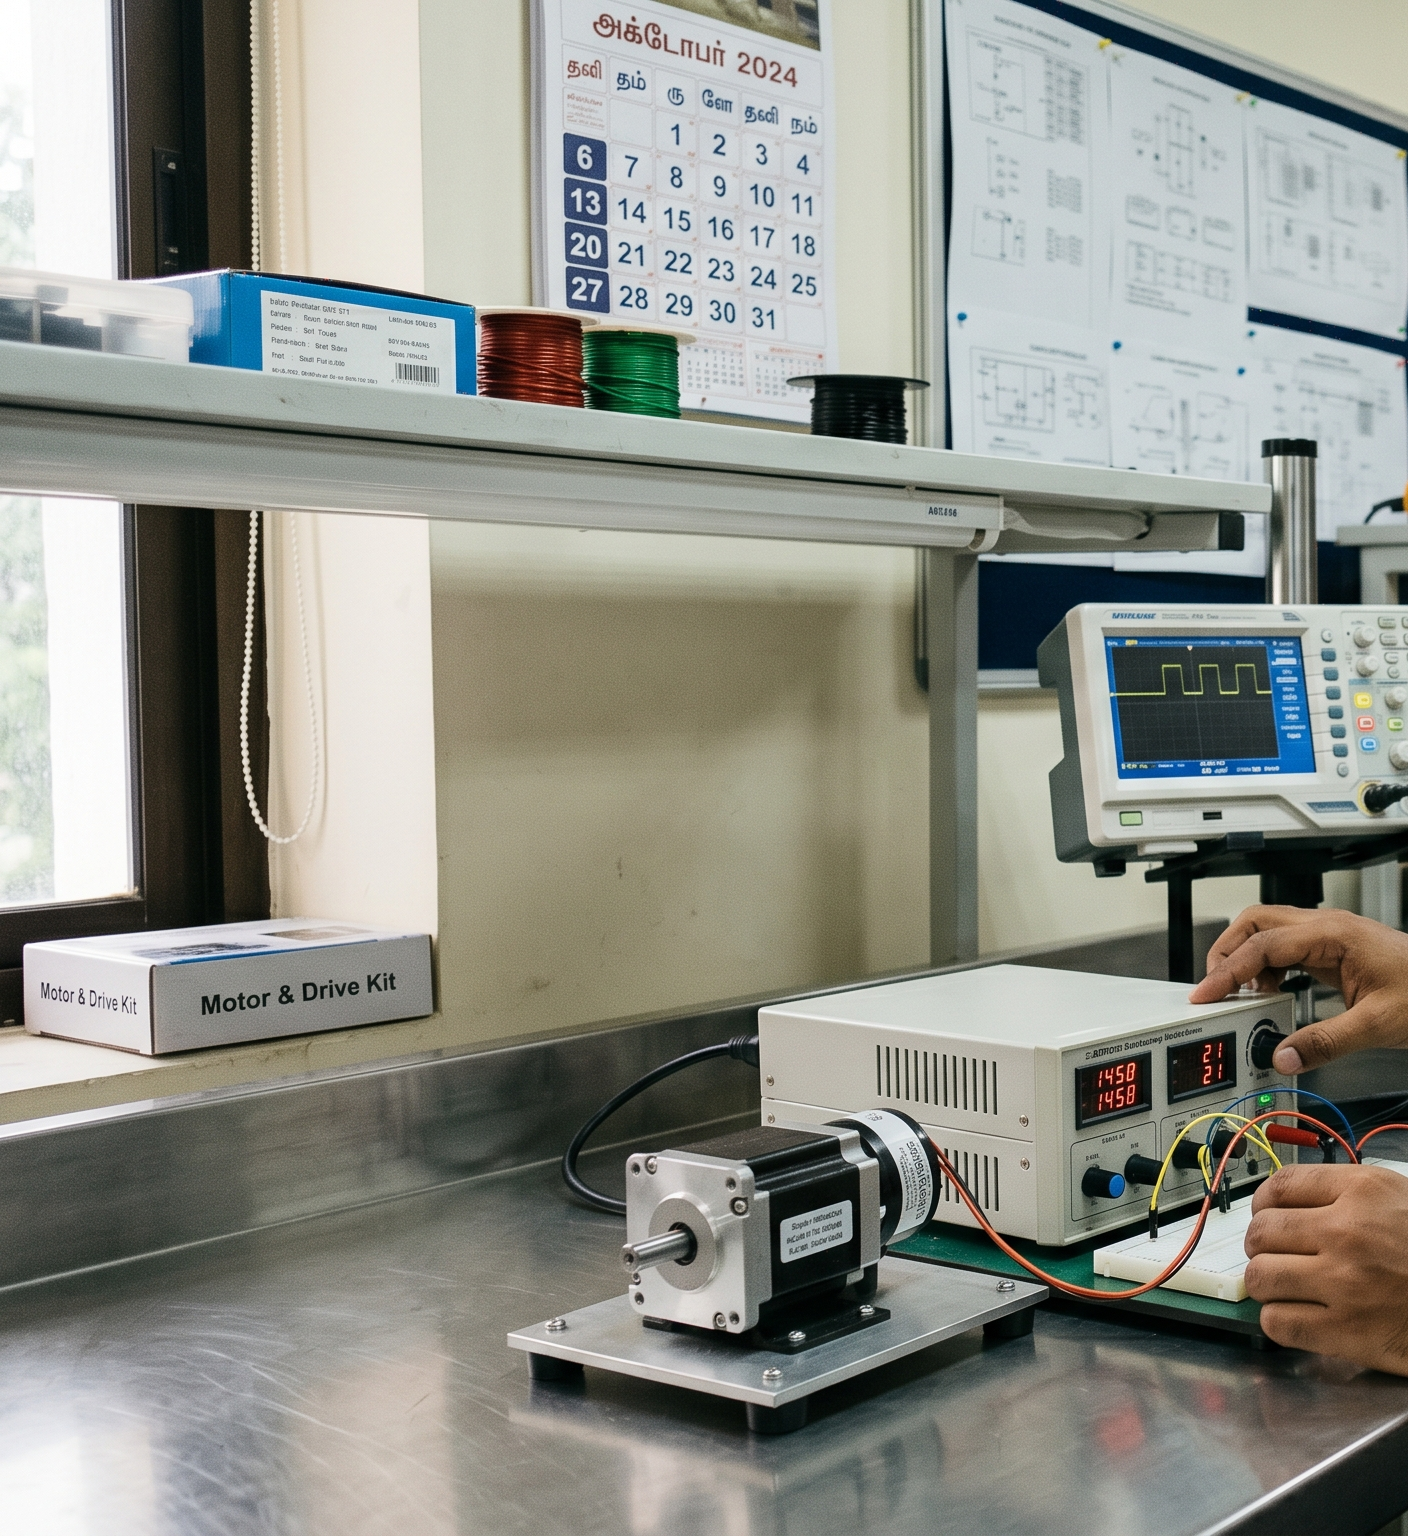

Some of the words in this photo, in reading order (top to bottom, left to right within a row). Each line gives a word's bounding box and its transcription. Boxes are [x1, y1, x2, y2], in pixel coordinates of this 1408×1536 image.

[593, 13, 726, 67] அக்டோபர்
[737, 52, 798, 88] 2024
[671, 124, 679, 145] 1
[713, 134, 726, 156] 2
[756, 143, 768, 165] 3
[797, 154, 809, 175] 4
[577, 144, 593, 170] 6
[625, 155, 638, 178] 7
[670, 166, 683, 188] 8
[714, 175, 726, 197] 9
[750, 183, 774, 207] 10
[792, 193, 812, 216] 11
[571, 188, 601, 215] 13
[618, 198, 646, 223] 14
[664, 207, 691, 232] 15
[708, 216, 734, 240] 16
[750, 225, 775, 248] 17
[792, 233, 815, 257] 18
[570, 232, 601, 259] 20
[618, 242, 644, 266] 21
[665, 250, 692, 274] 22
[708, 258, 734, 282] 23
[751, 266, 777, 290] 24
[792, 273, 817, 296] 25
[571, 276, 603, 302] 27
[620, 285, 648, 309] 28
[666, 293, 693, 316] 29
[710, 300, 735, 323] 30
[752, 307, 774, 330] 31
[41, 982, 75, 1003] Motor
[78, 988, 85, 1005] &
[89, 990, 118, 1011] Drive
[122, 995, 137, 1015] Kit
[201, 992, 271, 1015] Motor
[278, 985, 295, 1005] &
[302, 979, 360, 1002] Drive
[367, 972, 396, 993] Kit
[1202, 1042, 1222, 1063] 21
[1203, 1064, 1222, 1085] 21
[1098, 1084, 1136, 1111] 1458
